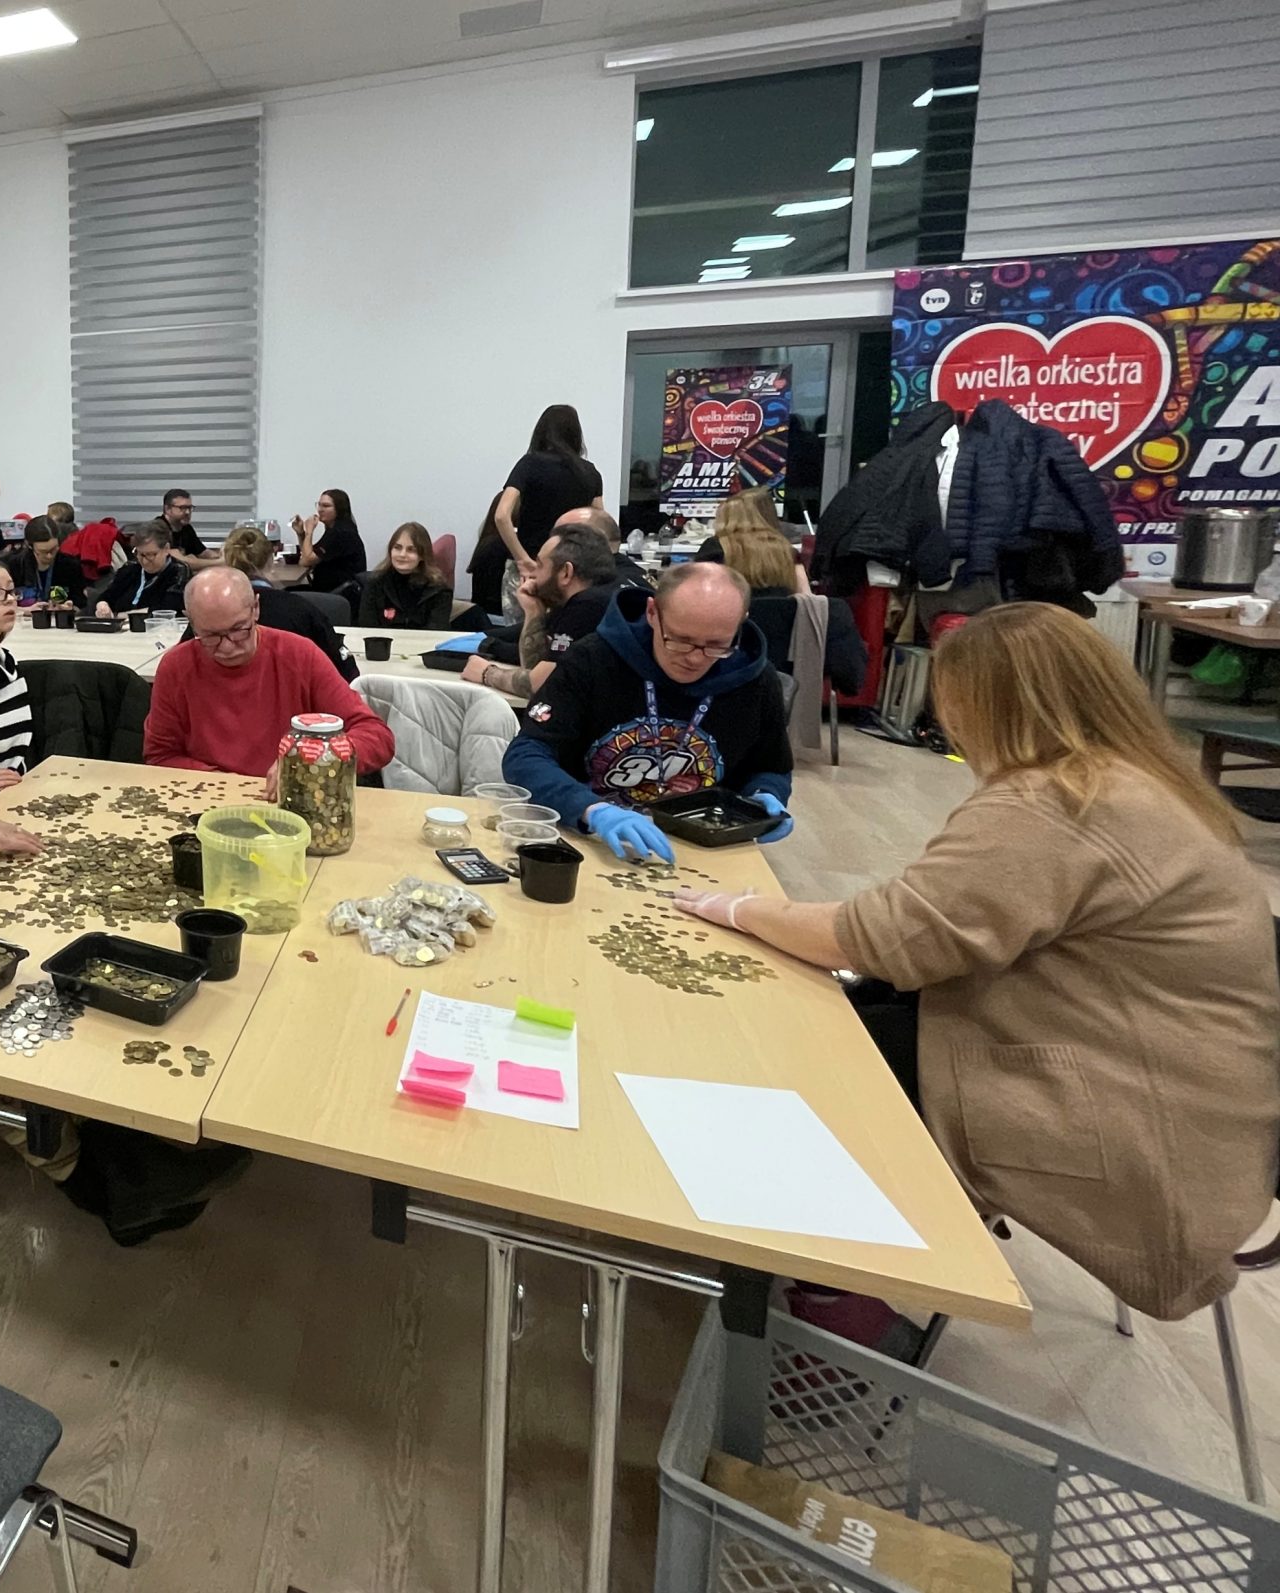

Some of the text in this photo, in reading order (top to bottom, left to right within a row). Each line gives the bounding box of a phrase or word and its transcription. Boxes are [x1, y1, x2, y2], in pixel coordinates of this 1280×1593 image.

[925, 296, 945, 304] tvn
[955, 352, 1142, 390] wielka orkiestra
[749, 372, 778, 390] 34
[1214, 365, 1280, 428] A
[677, 462, 694, 477] A
[1177, 489, 1280, 501] POMAGAN
